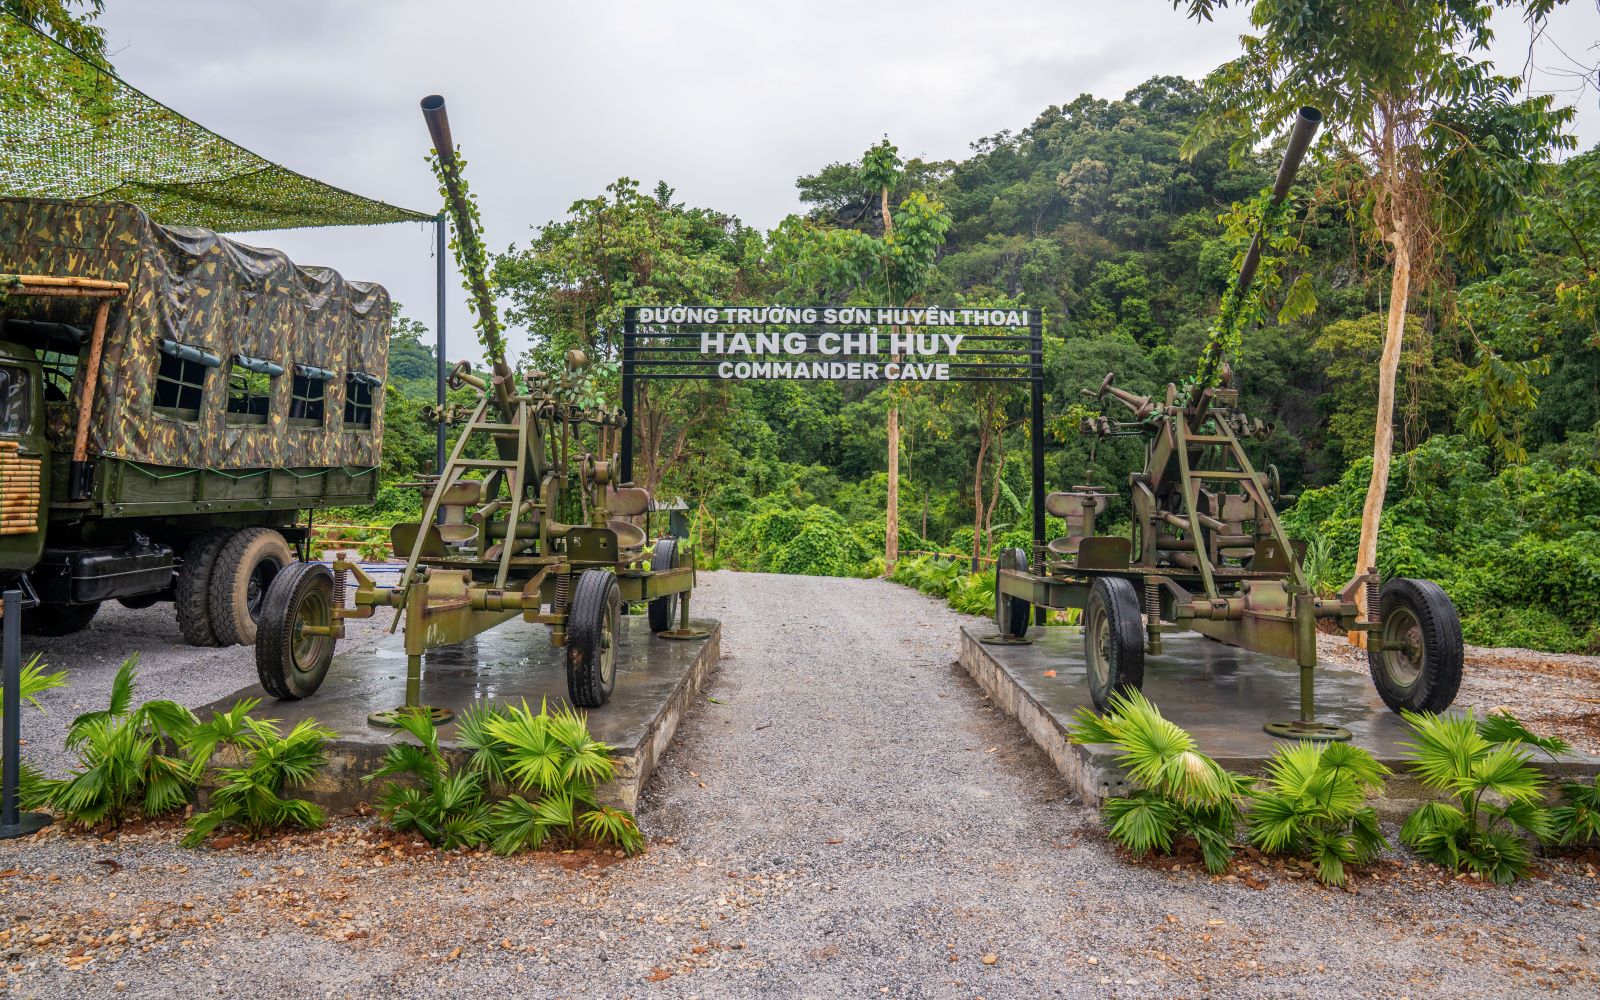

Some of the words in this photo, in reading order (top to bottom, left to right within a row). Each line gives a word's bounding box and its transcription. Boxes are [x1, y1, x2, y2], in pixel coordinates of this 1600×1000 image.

[639, 305, 719, 324] ĐƯỜNG
[723, 304, 817, 324] TRƯỜNG
[823, 307, 871, 325] SƠN
[877, 305, 955, 326] HUYỀN
[960, 310, 1029, 331] THOẠI
[700, 332, 807, 355] HANG
[818, 327, 878, 355] CHỈ
[890, 333, 965, 356] HUY
[718, 362, 879, 380] COMMANDER
[884, 363, 950, 381] CAVE
